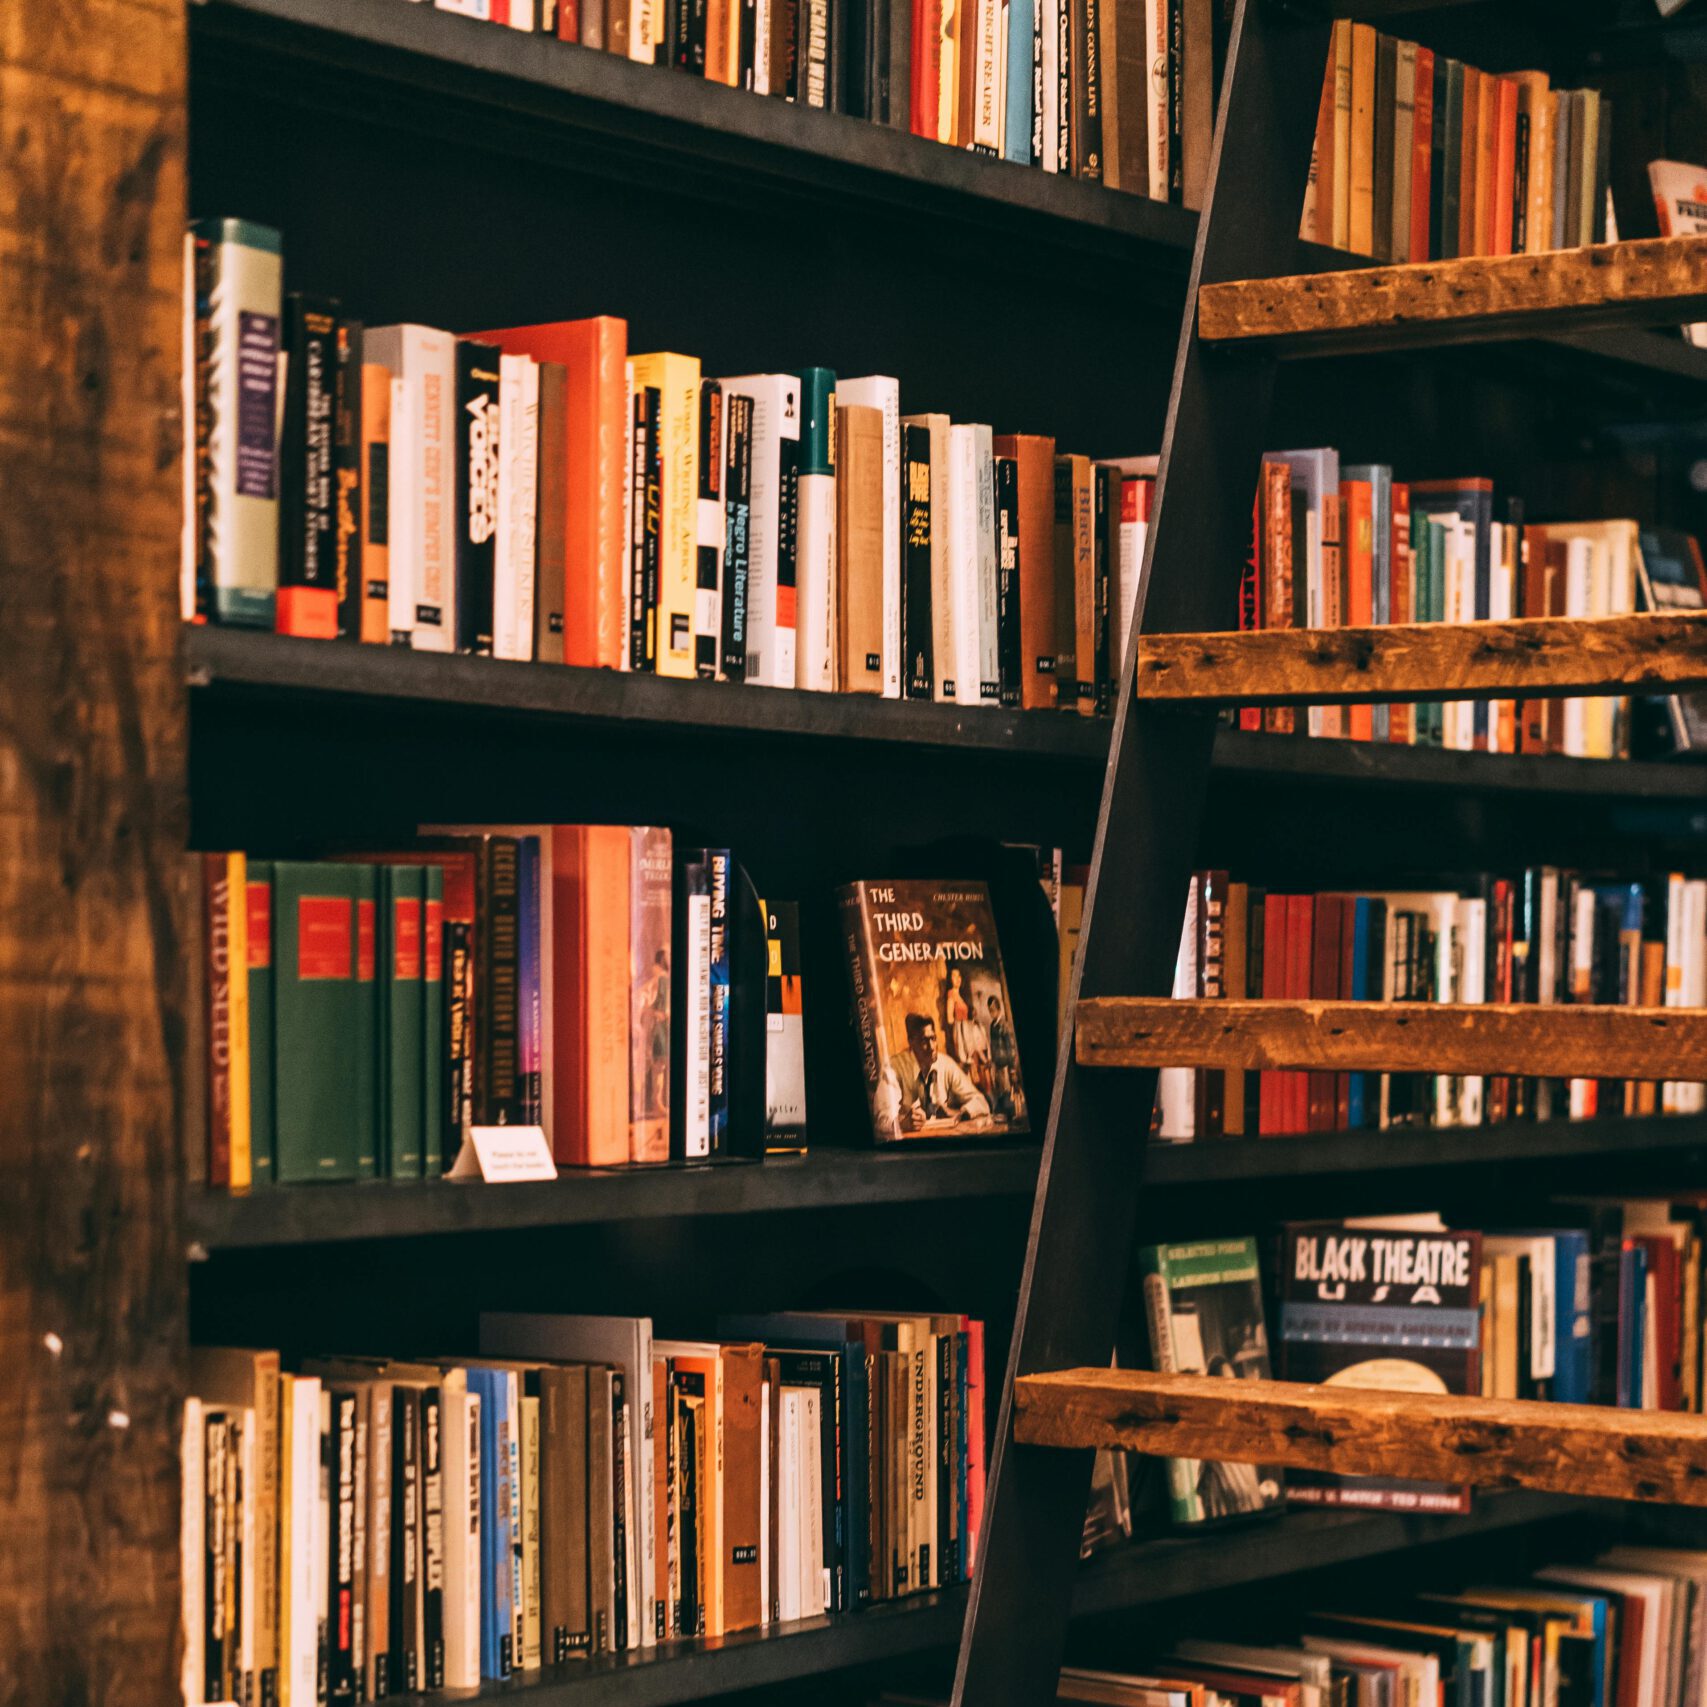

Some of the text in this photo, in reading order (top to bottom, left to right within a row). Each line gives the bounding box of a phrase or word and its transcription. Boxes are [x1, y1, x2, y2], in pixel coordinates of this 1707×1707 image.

[1087, 32, 1096, 82] GONNA
[981, 60, 994, 126] READER
[1034, 67, 1042, 113] Richard
[1059, 14, 1068, 170] Outsider Richard Wright
[1088, 87, 1097, 117] LIVE
[1032, 116, 1042, 157] Wright
[672, 416, 682, 432] The
[424, 374, 442, 600] BENNETT CERF'S BUMPER CROP
[465, 394, 489, 544] VOICES
[680, 388, 694, 584] WOMEN WRITING AFRICA
[670, 507, 681, 552] Region
[724, 500, 735, 567] in America
[779, 474, 788, 550] THE SELF
[1078, 486, 1092, 563] Black
[731, 504, 749, 642] Negro Literature
[938, 607, 950, 648] Africa
[711, 856, 726, 965] BUYING TIME
[869, 888, 895, 904] THE
[493, 914, 515, 960] DAVID
[873, 912, 923, 933] THIRD
[699, 945, 708, 987] WILLIAMS
[852, 955, 865, 995] THIRD
[879, 941, 984, 962] GENERATION
[493, 965, 515, 1032] ANTHONY
[858, 997, 878, 1083] GENERATION
[711, 1065, 723, 1096] YOUNG
[1295, 1237, 1469, 1292] BLACK THEATRE
[1318, 1284, 1441, 1304] U S A
[915, 1350, 925, 1501] UNDERGROUND
[376, 1425, 391, 1481] Theme
[1391, 1492, 1418, 1507] TED
[376, 1497, 390, 1576] Blackness
[425, 1471, 442, 1592] THE DUPLEX
[528, 1509, 540, 1543] Road
